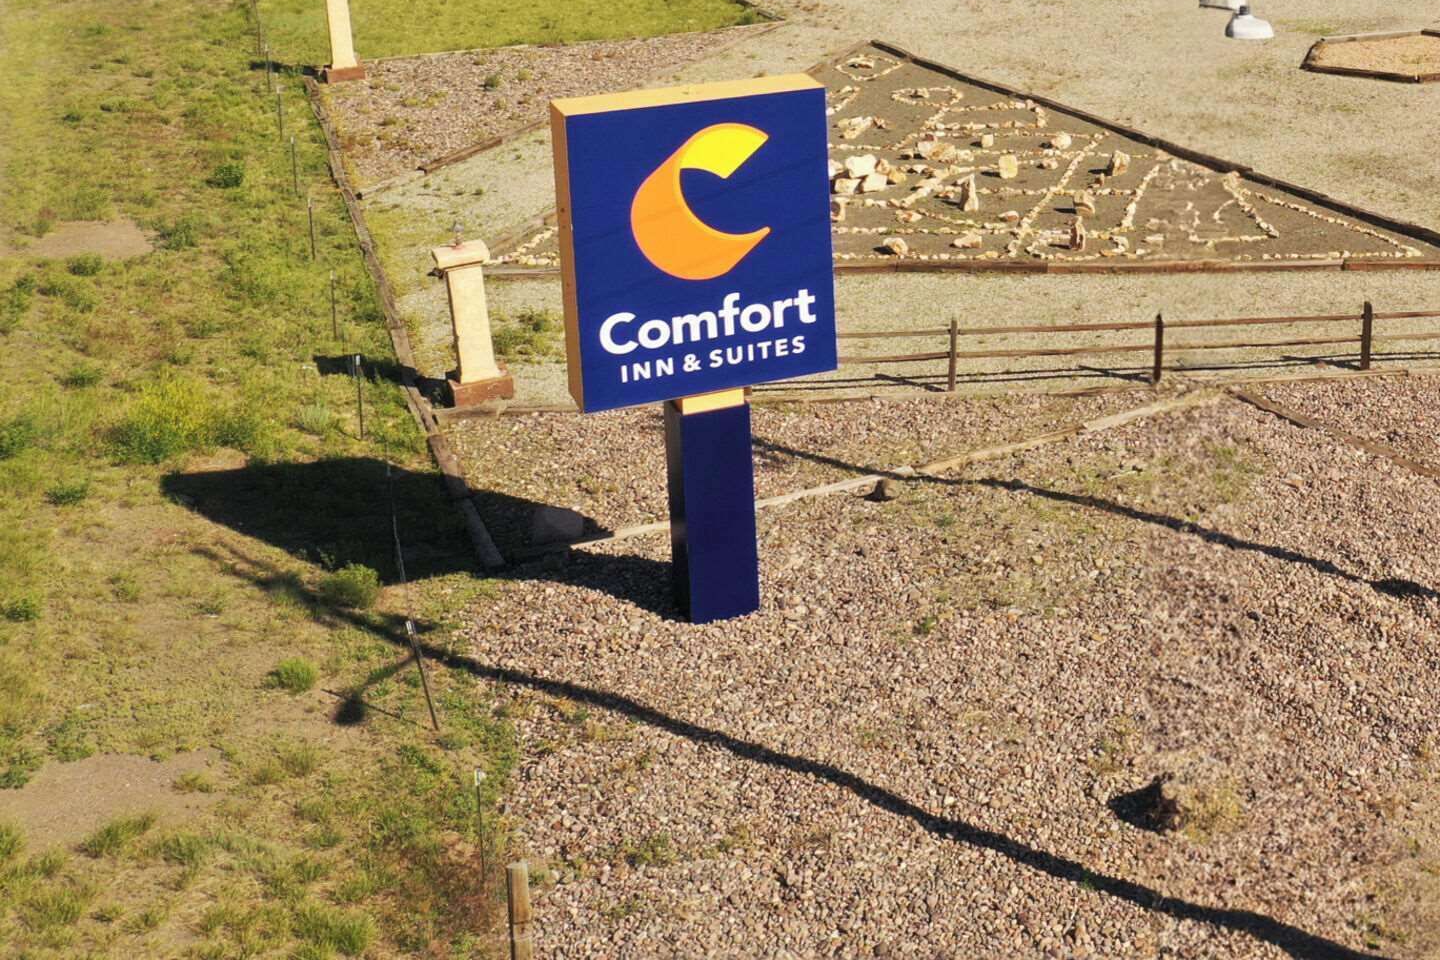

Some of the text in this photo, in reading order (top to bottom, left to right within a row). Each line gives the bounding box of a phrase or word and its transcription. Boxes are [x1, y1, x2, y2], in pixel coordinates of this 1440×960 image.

[599, 288, 817, 355] Comfort
[620, 335, 806, 383] INN & SUITES
